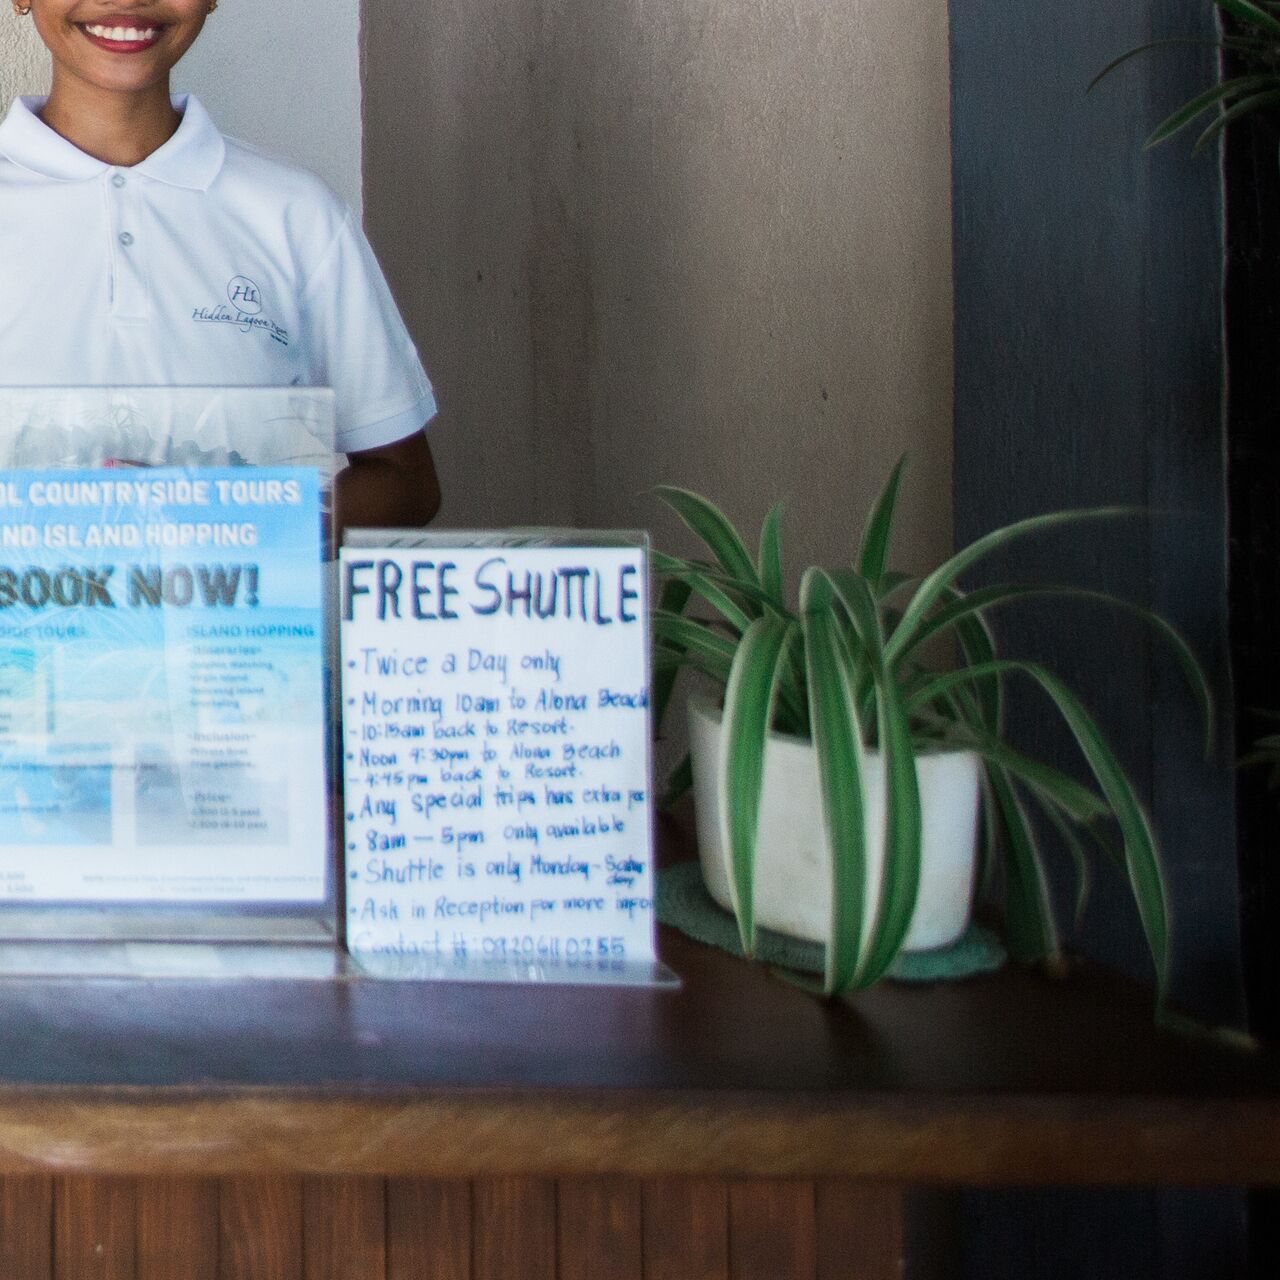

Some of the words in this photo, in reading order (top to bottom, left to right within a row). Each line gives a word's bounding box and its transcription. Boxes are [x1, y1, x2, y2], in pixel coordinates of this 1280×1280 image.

[232, 285, 259, 304] HL
[192, 305, 233, 320] Hidden
[29, 480, 209, 505] COUNTRYSIDE
[215, 480, 300, 504] TOURS
[43, 523, 138, 548] ISLAND
[145, 523, 257, 546] HOPPING
[129, 564, 259, 608] NOW!
[342, 559, 459, 622] FREE
[469, 557, 639, 625] SHUTTLE
[187, 624, 240, 637] ISLAND
[245, 624, 315, 637] HOPPING
[360, 647, 429, 676] Twice
[441, 651, 457, 673] a
[467, 648, 508, 684] Day
[520, 649, 561, 682] only
[361, 688, 443, 717] Morning
[455, 693, 500, 713] 10am
[509, 687, 526, 710] to
[535, 688, 587, 712] Alona
[432, 719, 475, 739] back
[483, 719, 498, 737] to
[359, 749, 397, 767] Noon
[482, 740, 497, 762] to
[561, 739, 621, 761] Beach
[440, 765, 483, 784] back
[496, 764, 511, 780] to
[360, 793, 397, 825] Any
[411, 785, 483, 819] special
[493, 784, 536, 811] trips
[544, 783, 574, 806] has
[582, 783, 621, 802] extra
[365, 828, 406, 852] 8am
[365, 857, 444, 884] Shuttle
[457, 858, 476, 877] is
[486, 851, 521, 884] only
[361, 899, 398, 920] Ask
[412, 898, 425, 918] in
[434, 895, 525, 923] Reception
[530, 899, 557, 921] for
[562, 897, 604, 911] more
[351, 930, 440, 955] Contact
